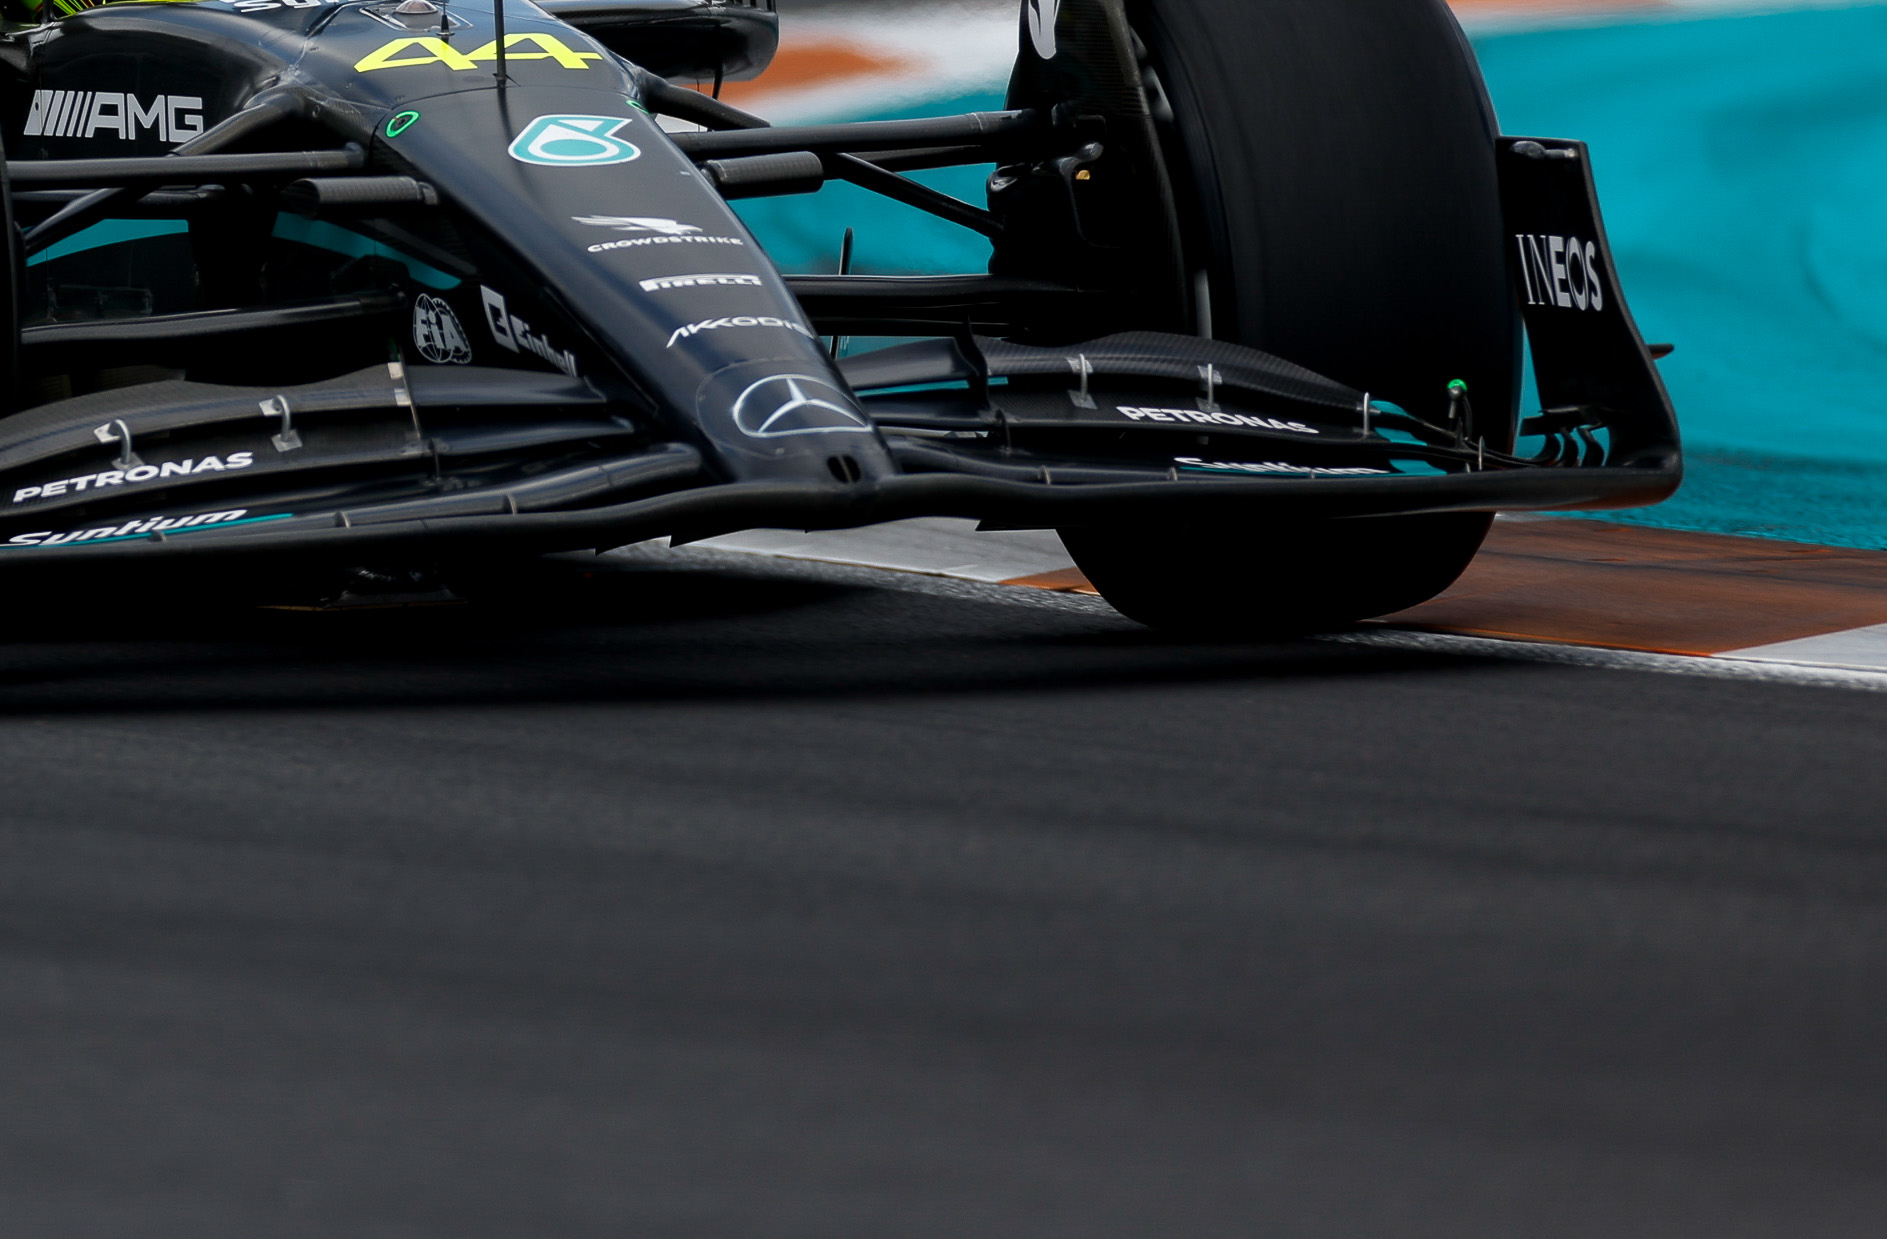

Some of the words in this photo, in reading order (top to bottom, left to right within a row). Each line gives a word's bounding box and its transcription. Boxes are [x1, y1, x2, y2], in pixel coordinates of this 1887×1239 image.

[354, 32, 603, 73] 44
[84, 91, 204, 142] AMG
[587, 235, 744, 253] CROWDSTRIKE
[639, 273, 762, 292] PIRELLI
[1515, 234, 1603, 311] INEOS
[509, 313, 577, 378] Einhell
[666, 316, 815, 349] AKKODIS
[1116, 405, 1320, 434] PETRONAS
[12, 452, 254, 503] PETRONAS
